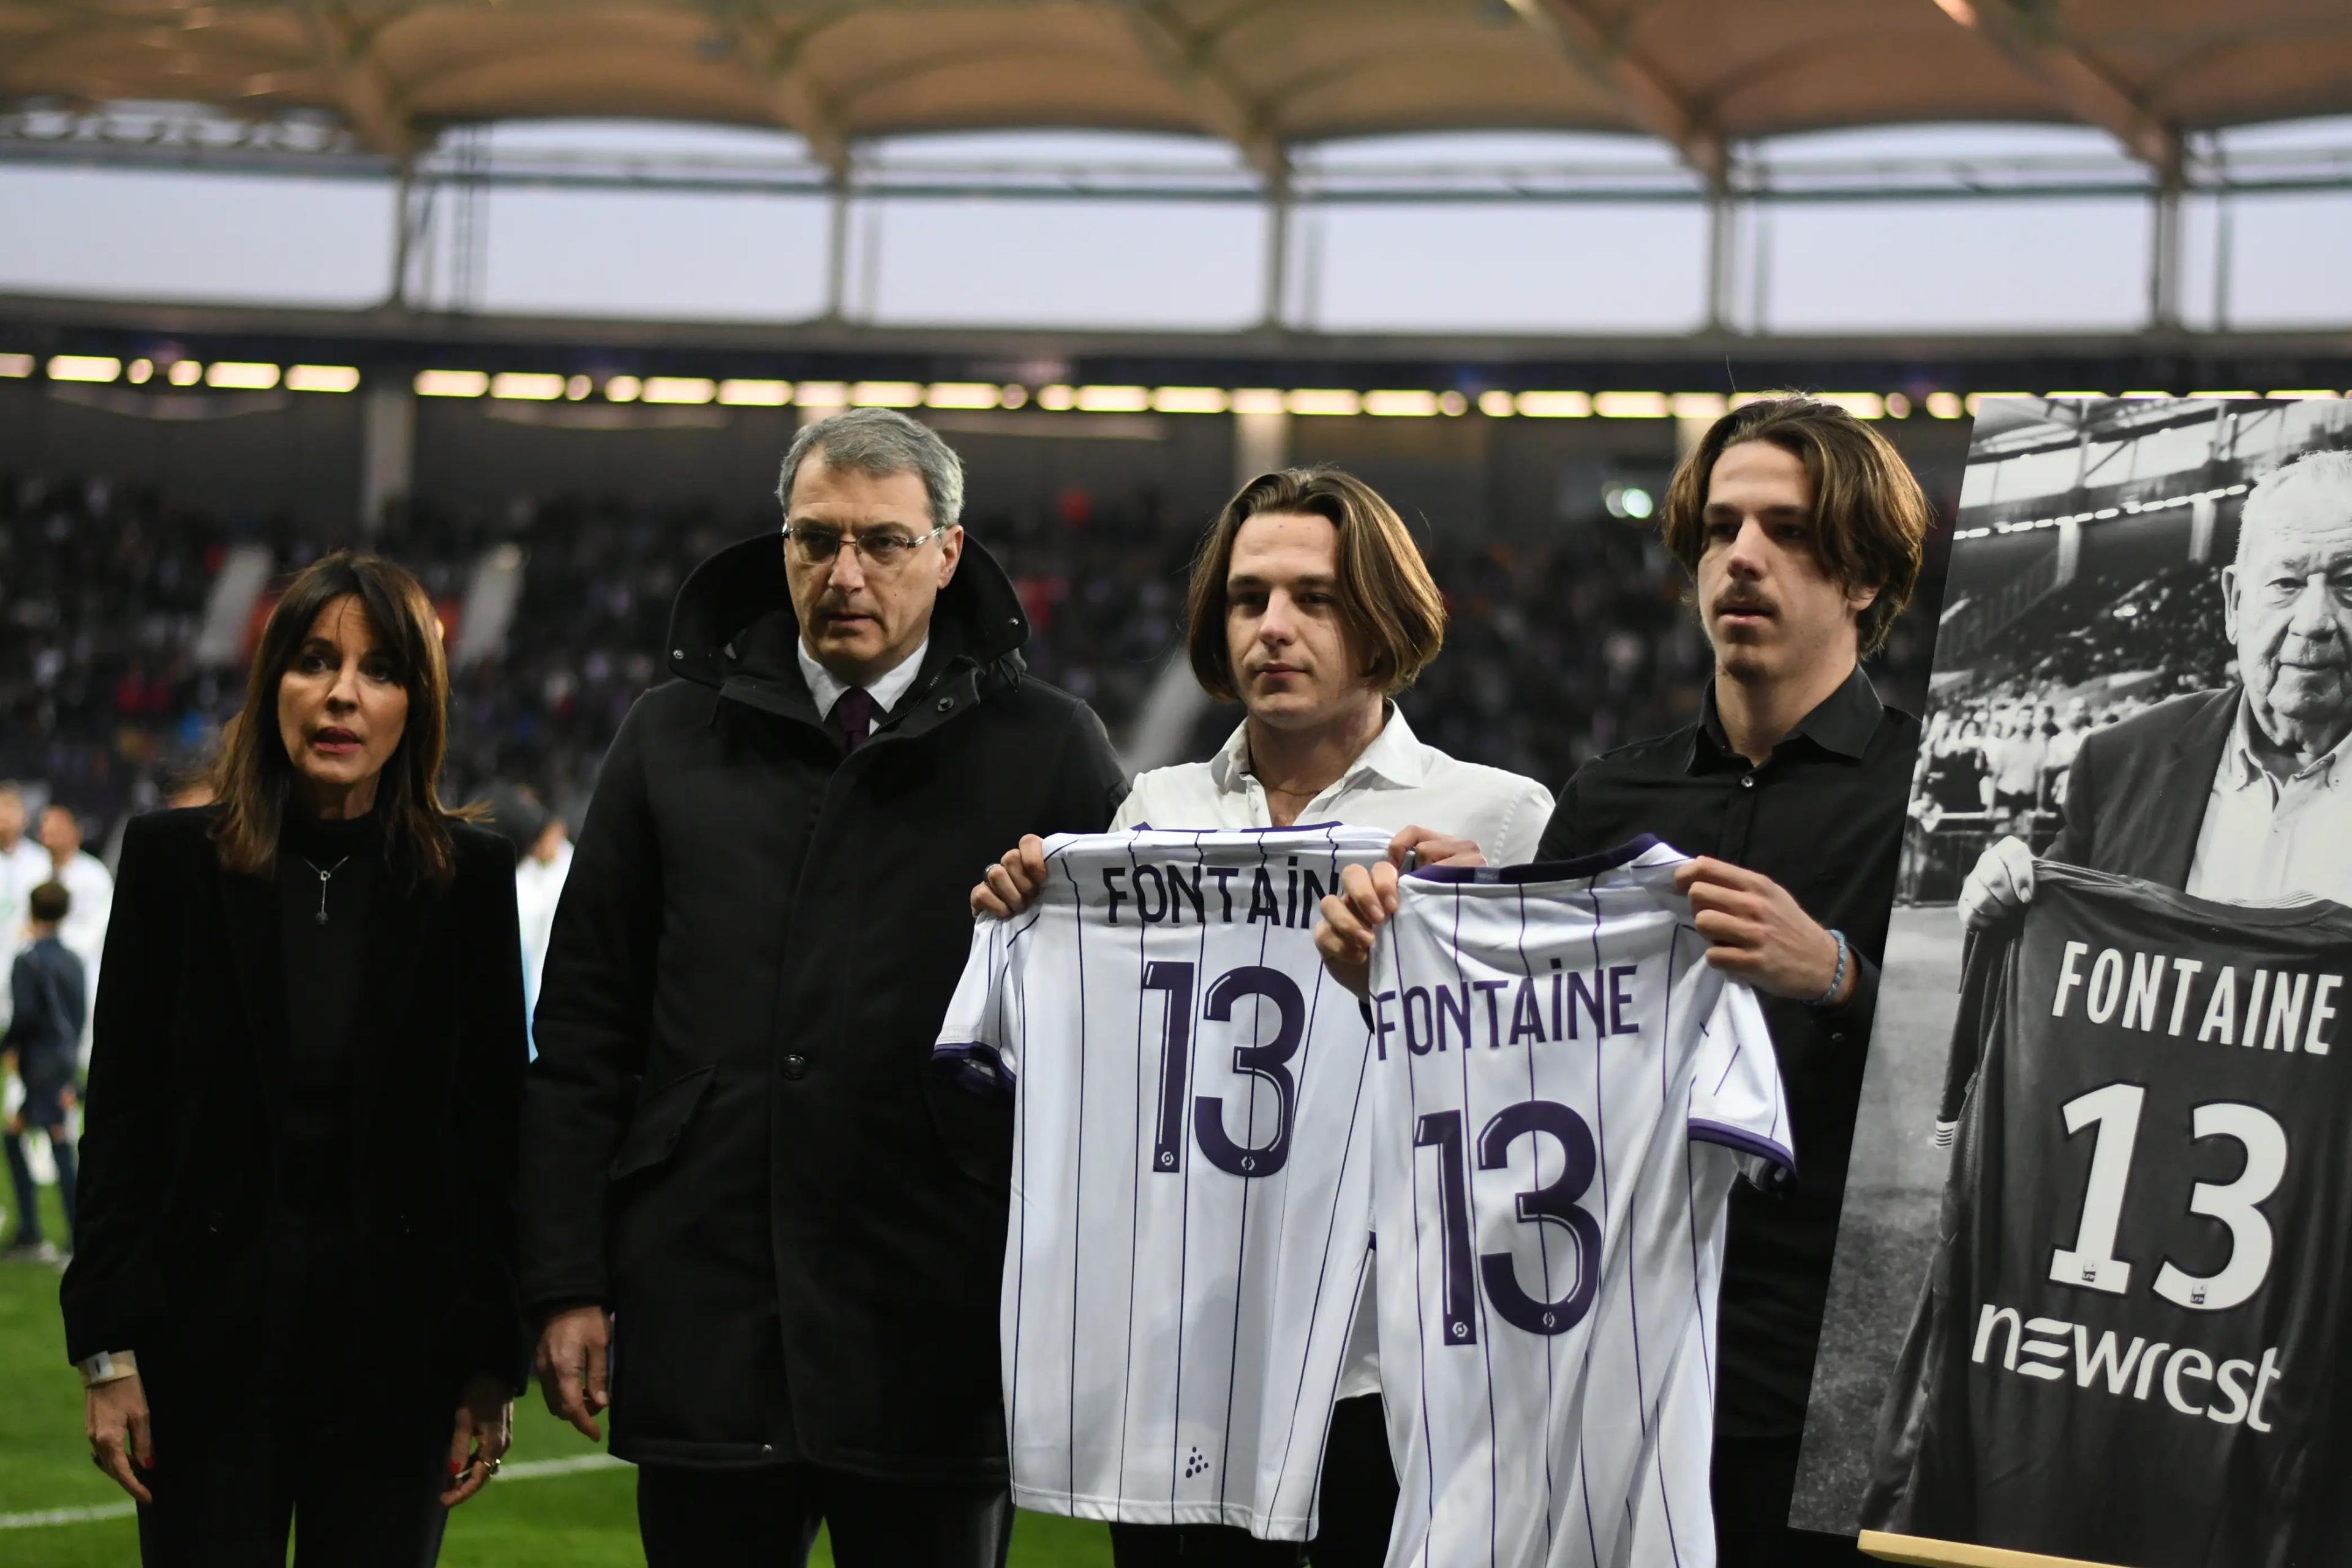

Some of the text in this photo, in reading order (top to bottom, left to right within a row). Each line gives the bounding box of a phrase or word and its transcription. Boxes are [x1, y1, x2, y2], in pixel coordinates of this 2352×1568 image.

[1143, 961, 1305, 1178] 13
[2052, 940, 2343, 1055] FONTAINE
[1414, 1100, 1602, 1346] 13
[2049, 1082, 2288, 1310] 13
